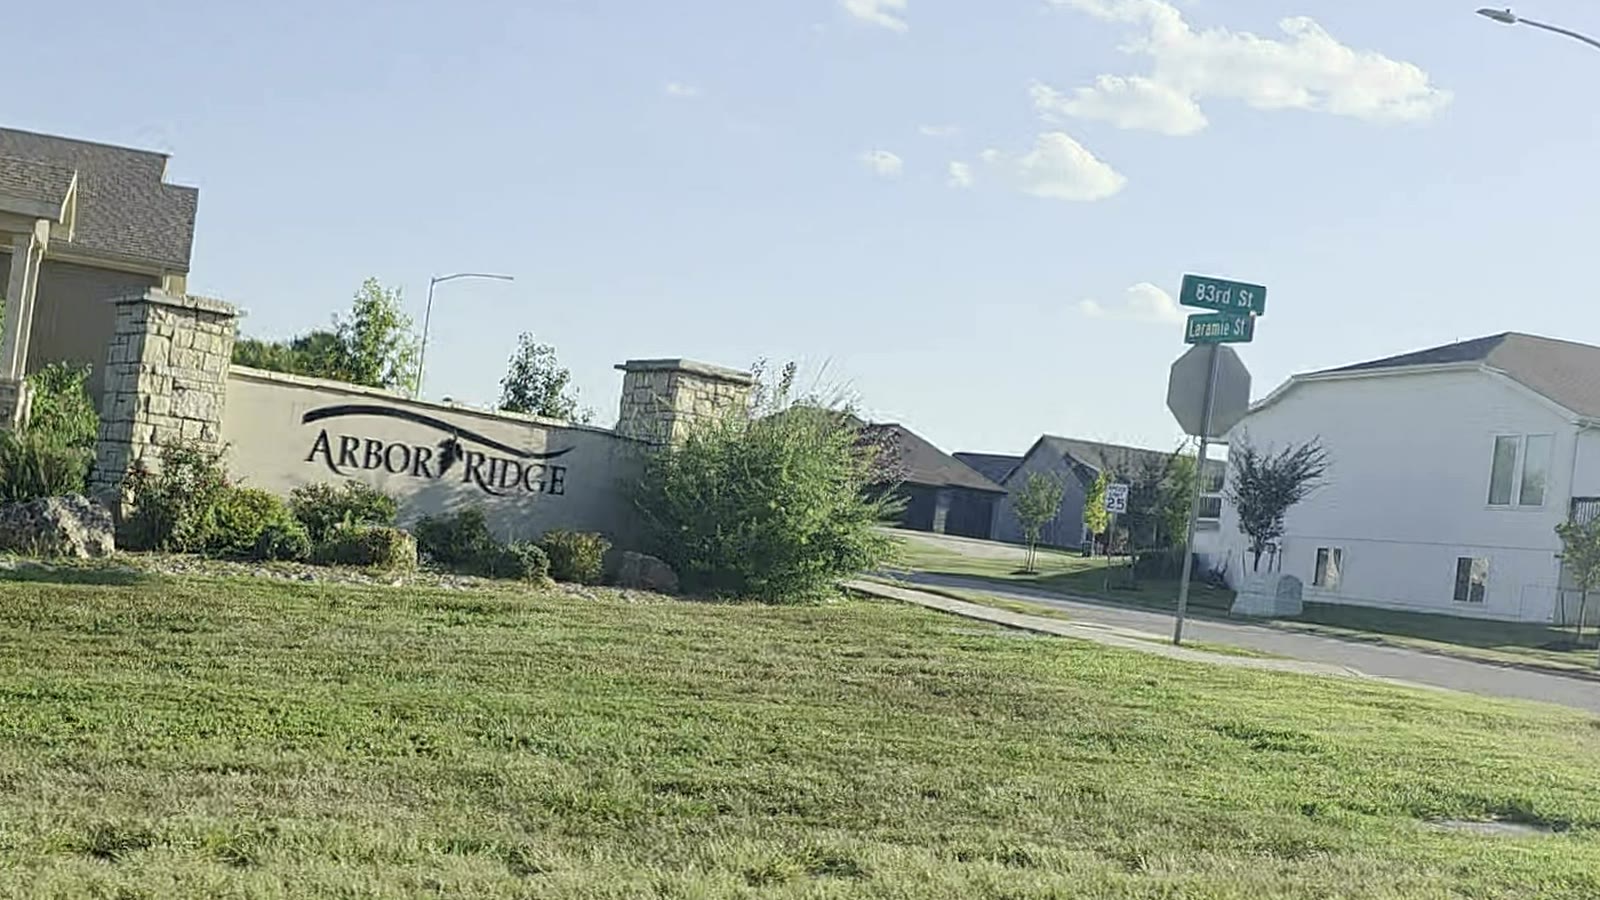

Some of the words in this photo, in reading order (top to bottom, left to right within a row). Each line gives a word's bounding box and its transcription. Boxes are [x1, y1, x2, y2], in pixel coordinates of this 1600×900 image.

[1195, 283, 1231, 304] 83rd
[1237, 290, 1253, 307] St
[1189, 320, 1230, 337] Laramie
[1233, 318, 1245, 336] St
[304, 429, 433, 479] ARBOR
[462, 451, 567, 496] RIDGE
[1107, 497, 1125, 510] 25
